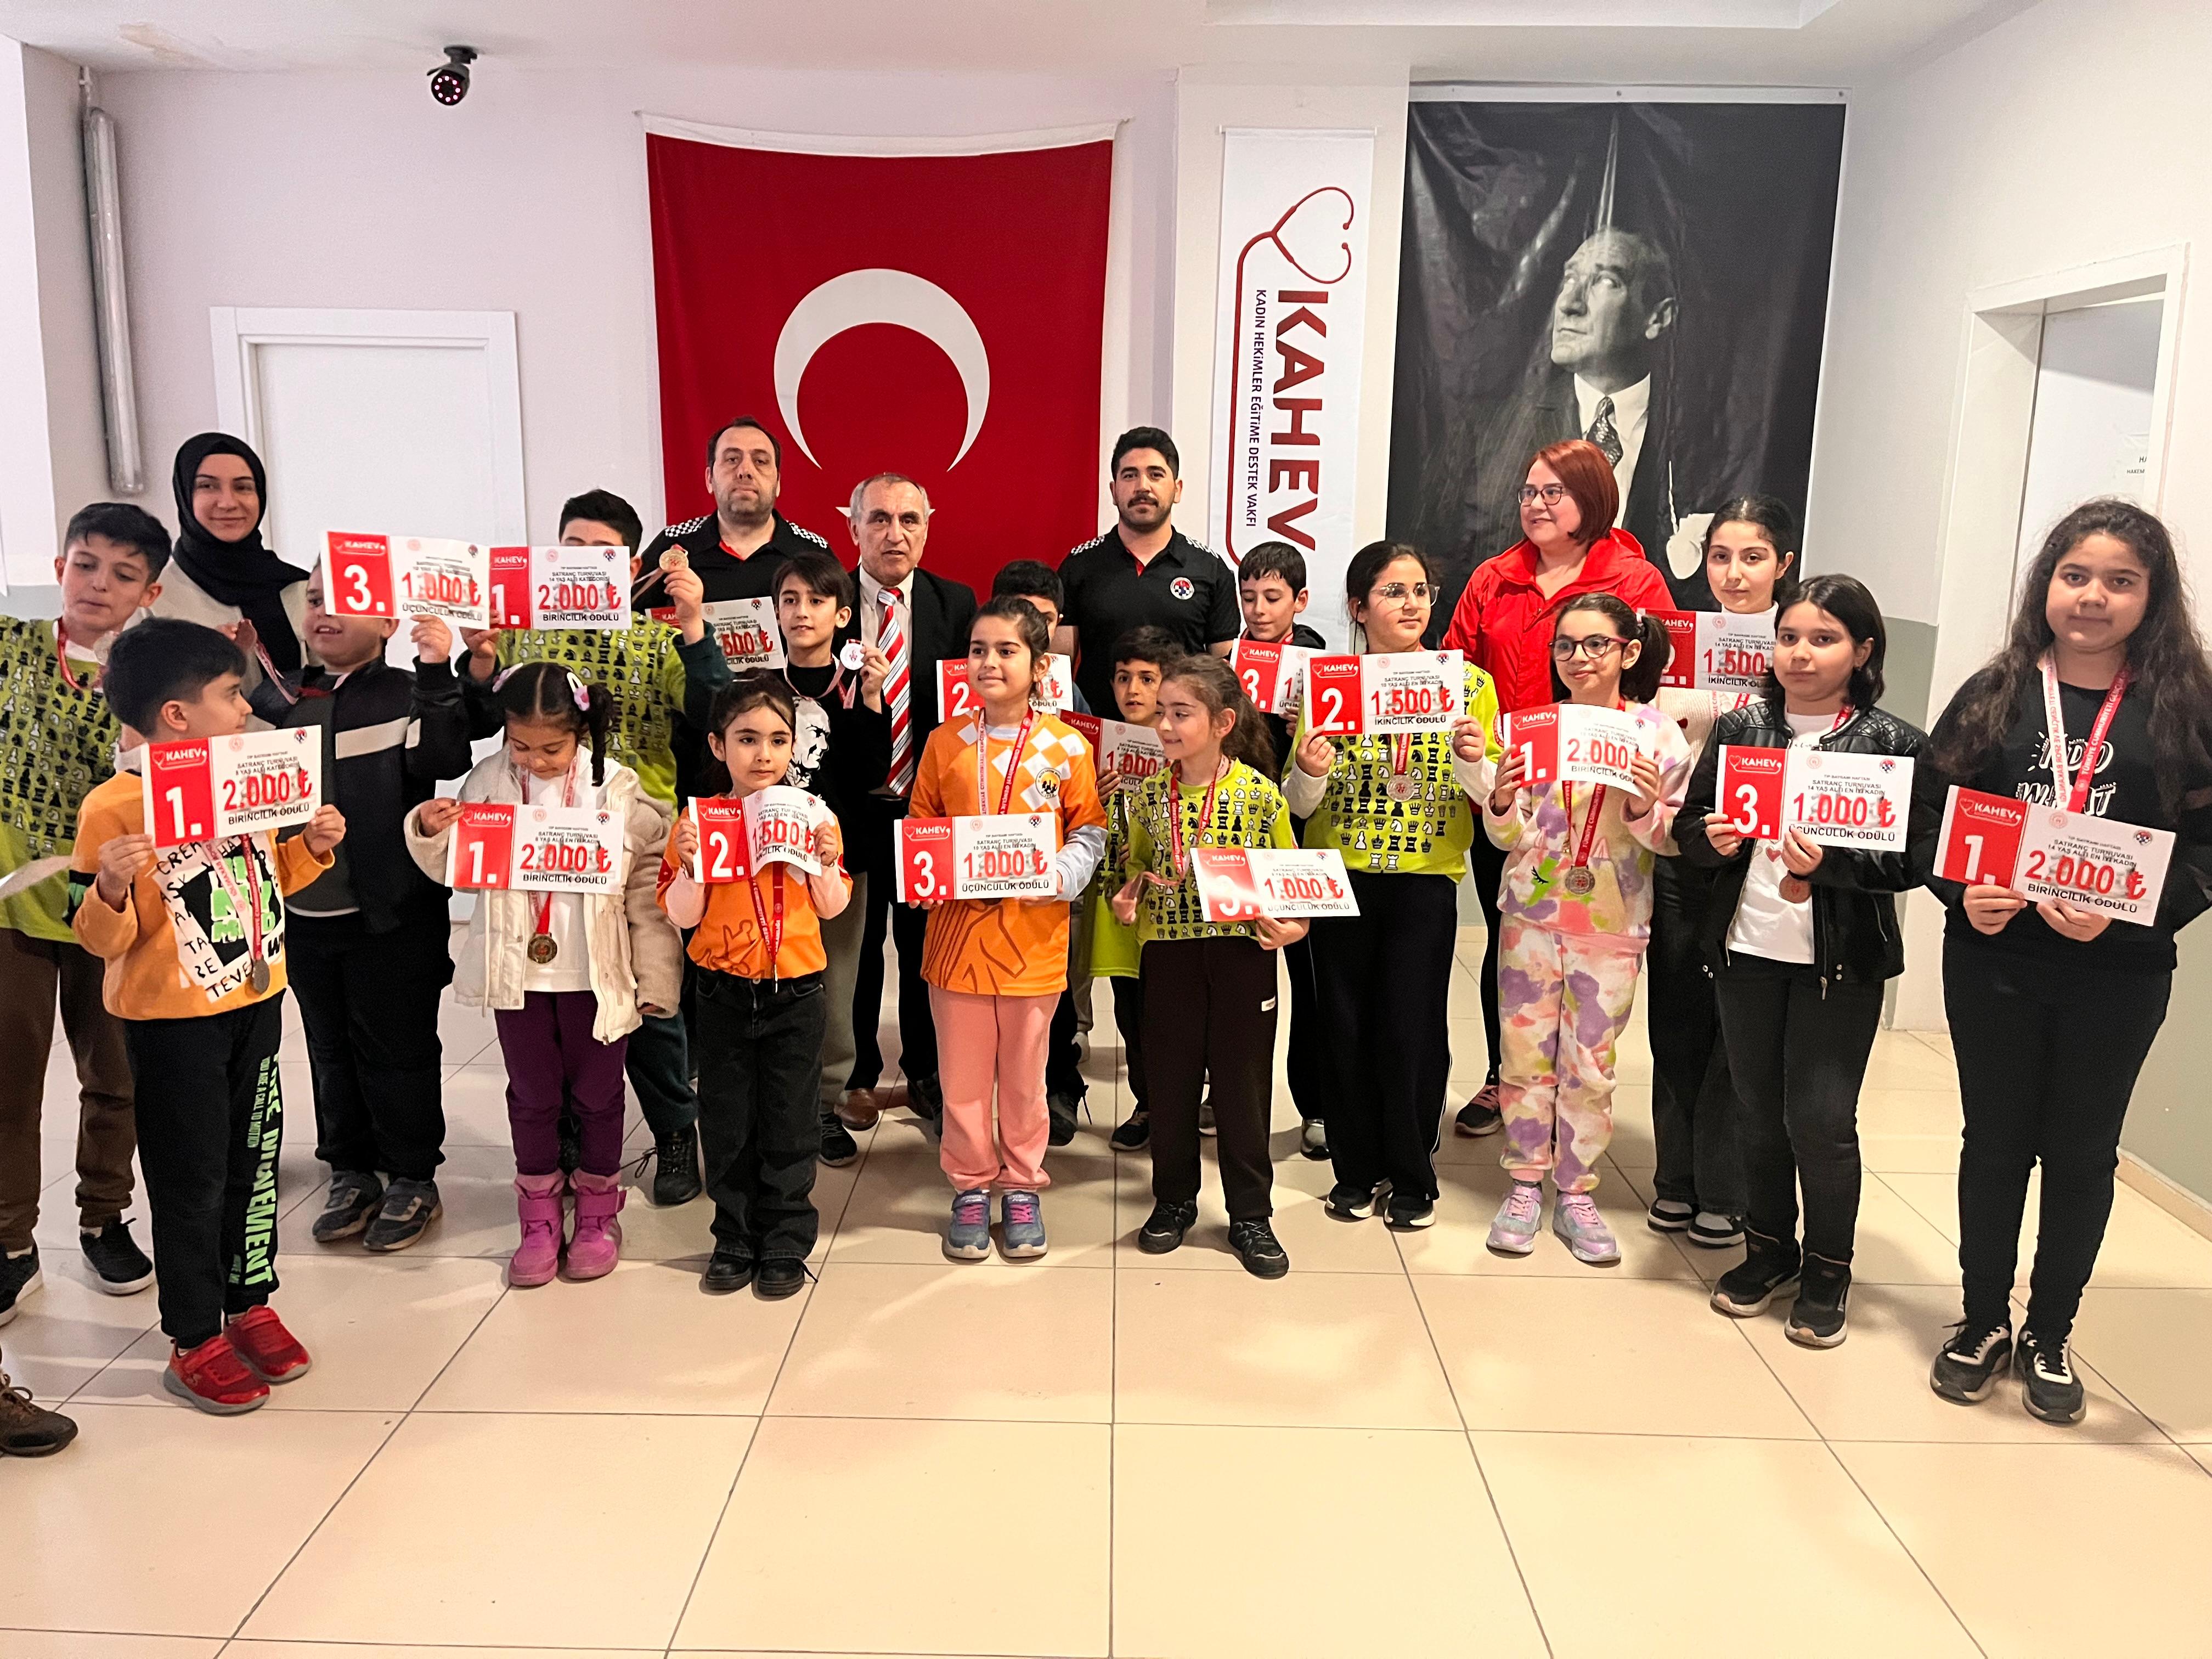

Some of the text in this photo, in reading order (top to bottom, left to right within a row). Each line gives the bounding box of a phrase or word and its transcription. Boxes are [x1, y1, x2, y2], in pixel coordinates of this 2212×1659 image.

[1254, 289, 1267, 329] KADIN
[1267, 290, 1329, 551] KAHEV
[1247, 447, 1259, 490] DESTEK
[1245, 493, 1257, 527] VAKFI
[494, 556, 523, 565] KAHEV
[344, 565, 385, 611] 3.
[402, 572, 462, 603] 1.000
[538, 584, 599, 610] 2.000
[492, 584, 520, 625] 1.
[721, 631, 755, 656] 500
[1249, 648, 1276, 658] KAHEV
[1323, 664, 1354, 673] KAHEV
[1703, 648, 1765, 676] 1.500
[1242, 668, 1266, 709] 3.
[1708, 675, 1747, 687] İKİNCİLİK
[951, 681, 980, 717] 2.
[1321, 687, 1356, 731] 2.
[1371, 688, 1431, 715] 1.500
[1070, 718, 1094, 729] KAHEV
[1375, 715, 1446, 725] İKİNCİLİK ÖDÜLÜ
[1522, 712, 1551, 723] KAHEV
[2081, 703, 2113, 775] TÜRKİYE CUMHURİYETİ
[166, 748, 202, 761] KAHEV
[1520, 741, 1547, 782] 1.
[1567, 738, 1628, 770] 2.000
[1741, 757, 1777, 768] KAHEV
[1571, 765, 1618, 778] BİRİNCİLİK
[223, 771, 290, 811] 2.000
[166, 786, 202, 839] 1.
[228, 803, 309, 825] BİRİNCİLİK ÖDÜLÜ
[473, 812, 506, 821] KAHEV
[708, 806, 736, 816] KAHEV
[1733, 784, 1770, 836] 3.
[1793, 793, 1867, 826] 1.000
[1974, 802, 2015, 820] KAHEV
[916, 825, 946, 834] KAHEV
[1788, 823, 1895, 842] ÜÇÜNCÜLÜK ÖDÜLÜ
[469, 841, 497, 884] 1.
[520, 844, 588, 872] 2.000
[709, 831, 744, 878] 2.
[1964, 835, 1996, 885] 1.
[2054, 839, 2133, 860] SATRANÇ TURNUVASI
[913, 850, 947, 897] 3.
[963, 850, 1024, 878] 1.000
[2024, 850, 2114, 894] 2.000
[523, 873, 607, 885] BİRİNCİLİK ÖDÜLÜ
[962, 879, 1049, 894] ÜÇÜNCÜLÜK ÖDÜLÜ
[1264, 878, 1323, 899] 1.000
[2028, 882, 2137, 913] BİRİNCİLİK ÖDÜLÜ
[245, 1127, 280, 1285] MOVEMENT
